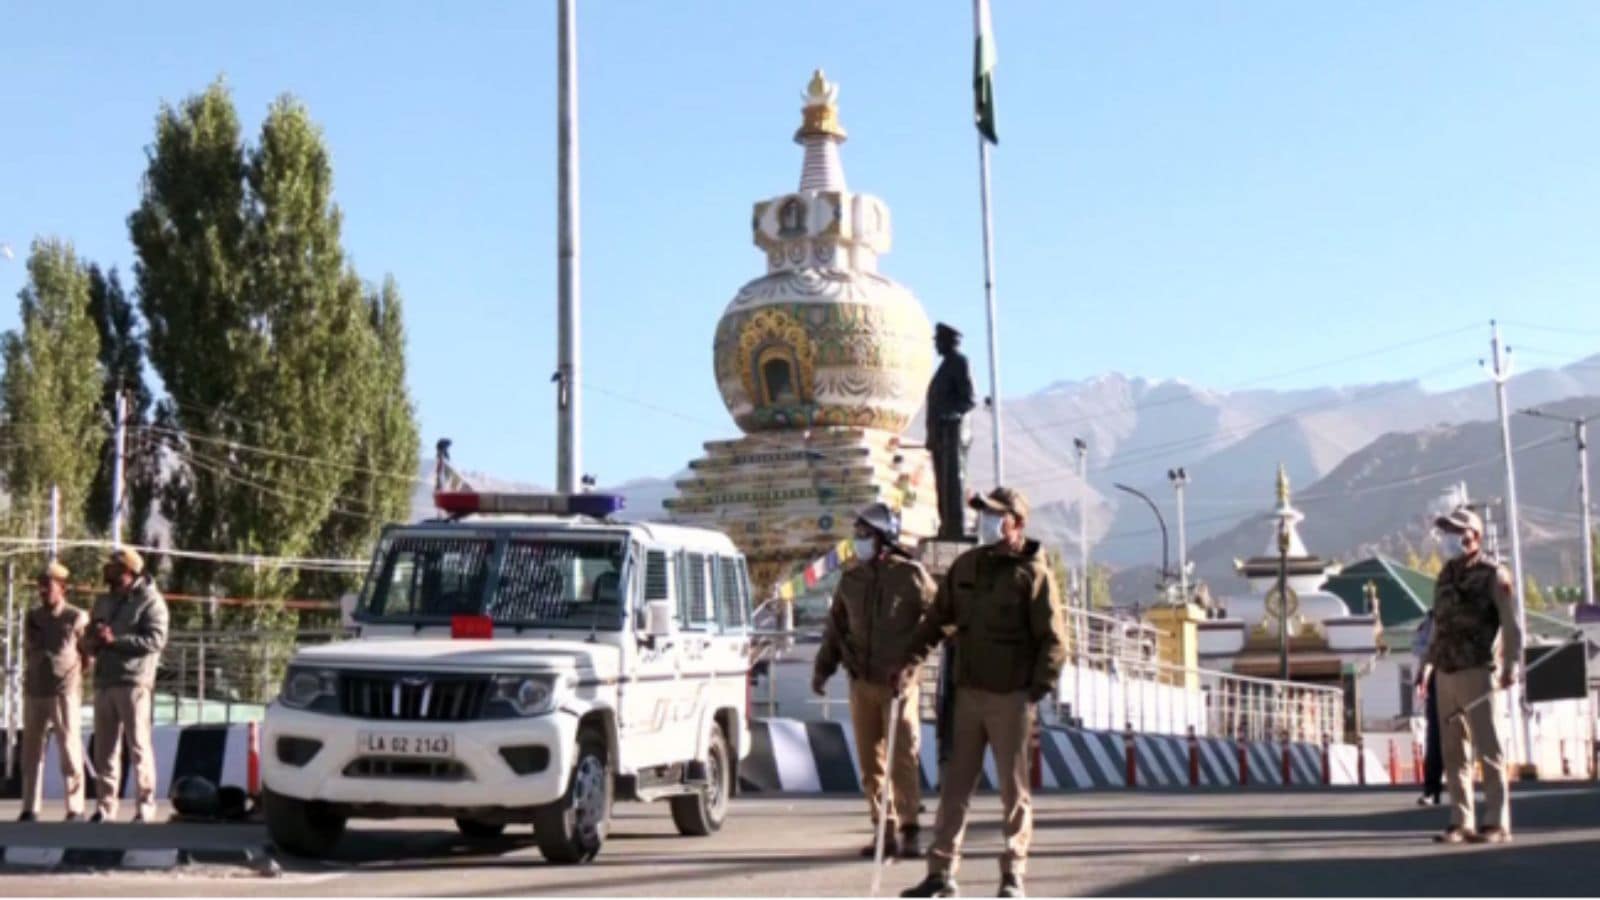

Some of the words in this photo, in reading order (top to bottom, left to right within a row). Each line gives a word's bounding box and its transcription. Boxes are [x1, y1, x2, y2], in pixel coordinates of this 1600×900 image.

[367, 734, 386, 751] LA
[391, 736, 409, 752] 02
[414, 736, 449, 753] 2143
